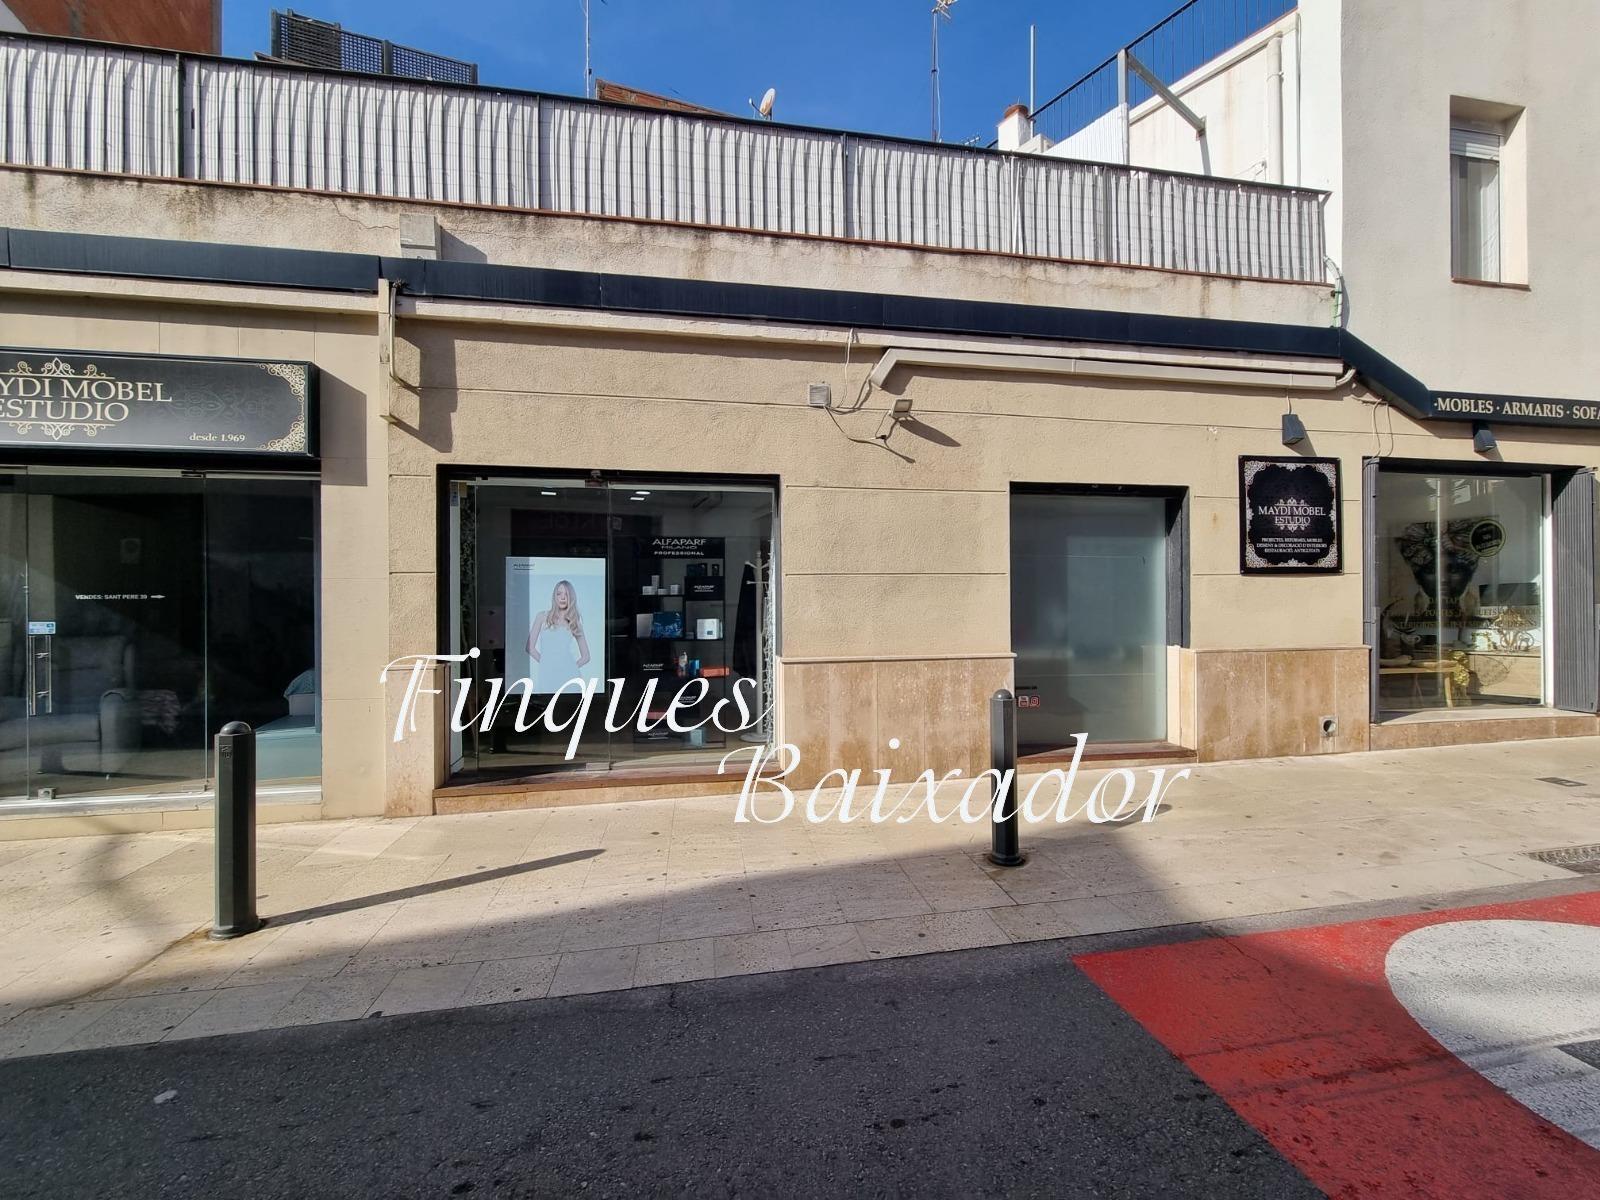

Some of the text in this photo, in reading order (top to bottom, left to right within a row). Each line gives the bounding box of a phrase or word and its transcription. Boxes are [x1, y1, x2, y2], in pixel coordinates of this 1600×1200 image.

[63, 379, 172, 402] MOBEL
[1502, 401, 1564, 417] ARMARIS
[1572, 405, 1600, 420] SOF
[189, 432, 218, 441] desde
[1258, 505, 1326, 516] MAYDI MOBEL
[1275, 516, 1311, 524] ESTUDIO
[652, 538, 707, 546] ALFAPARF
